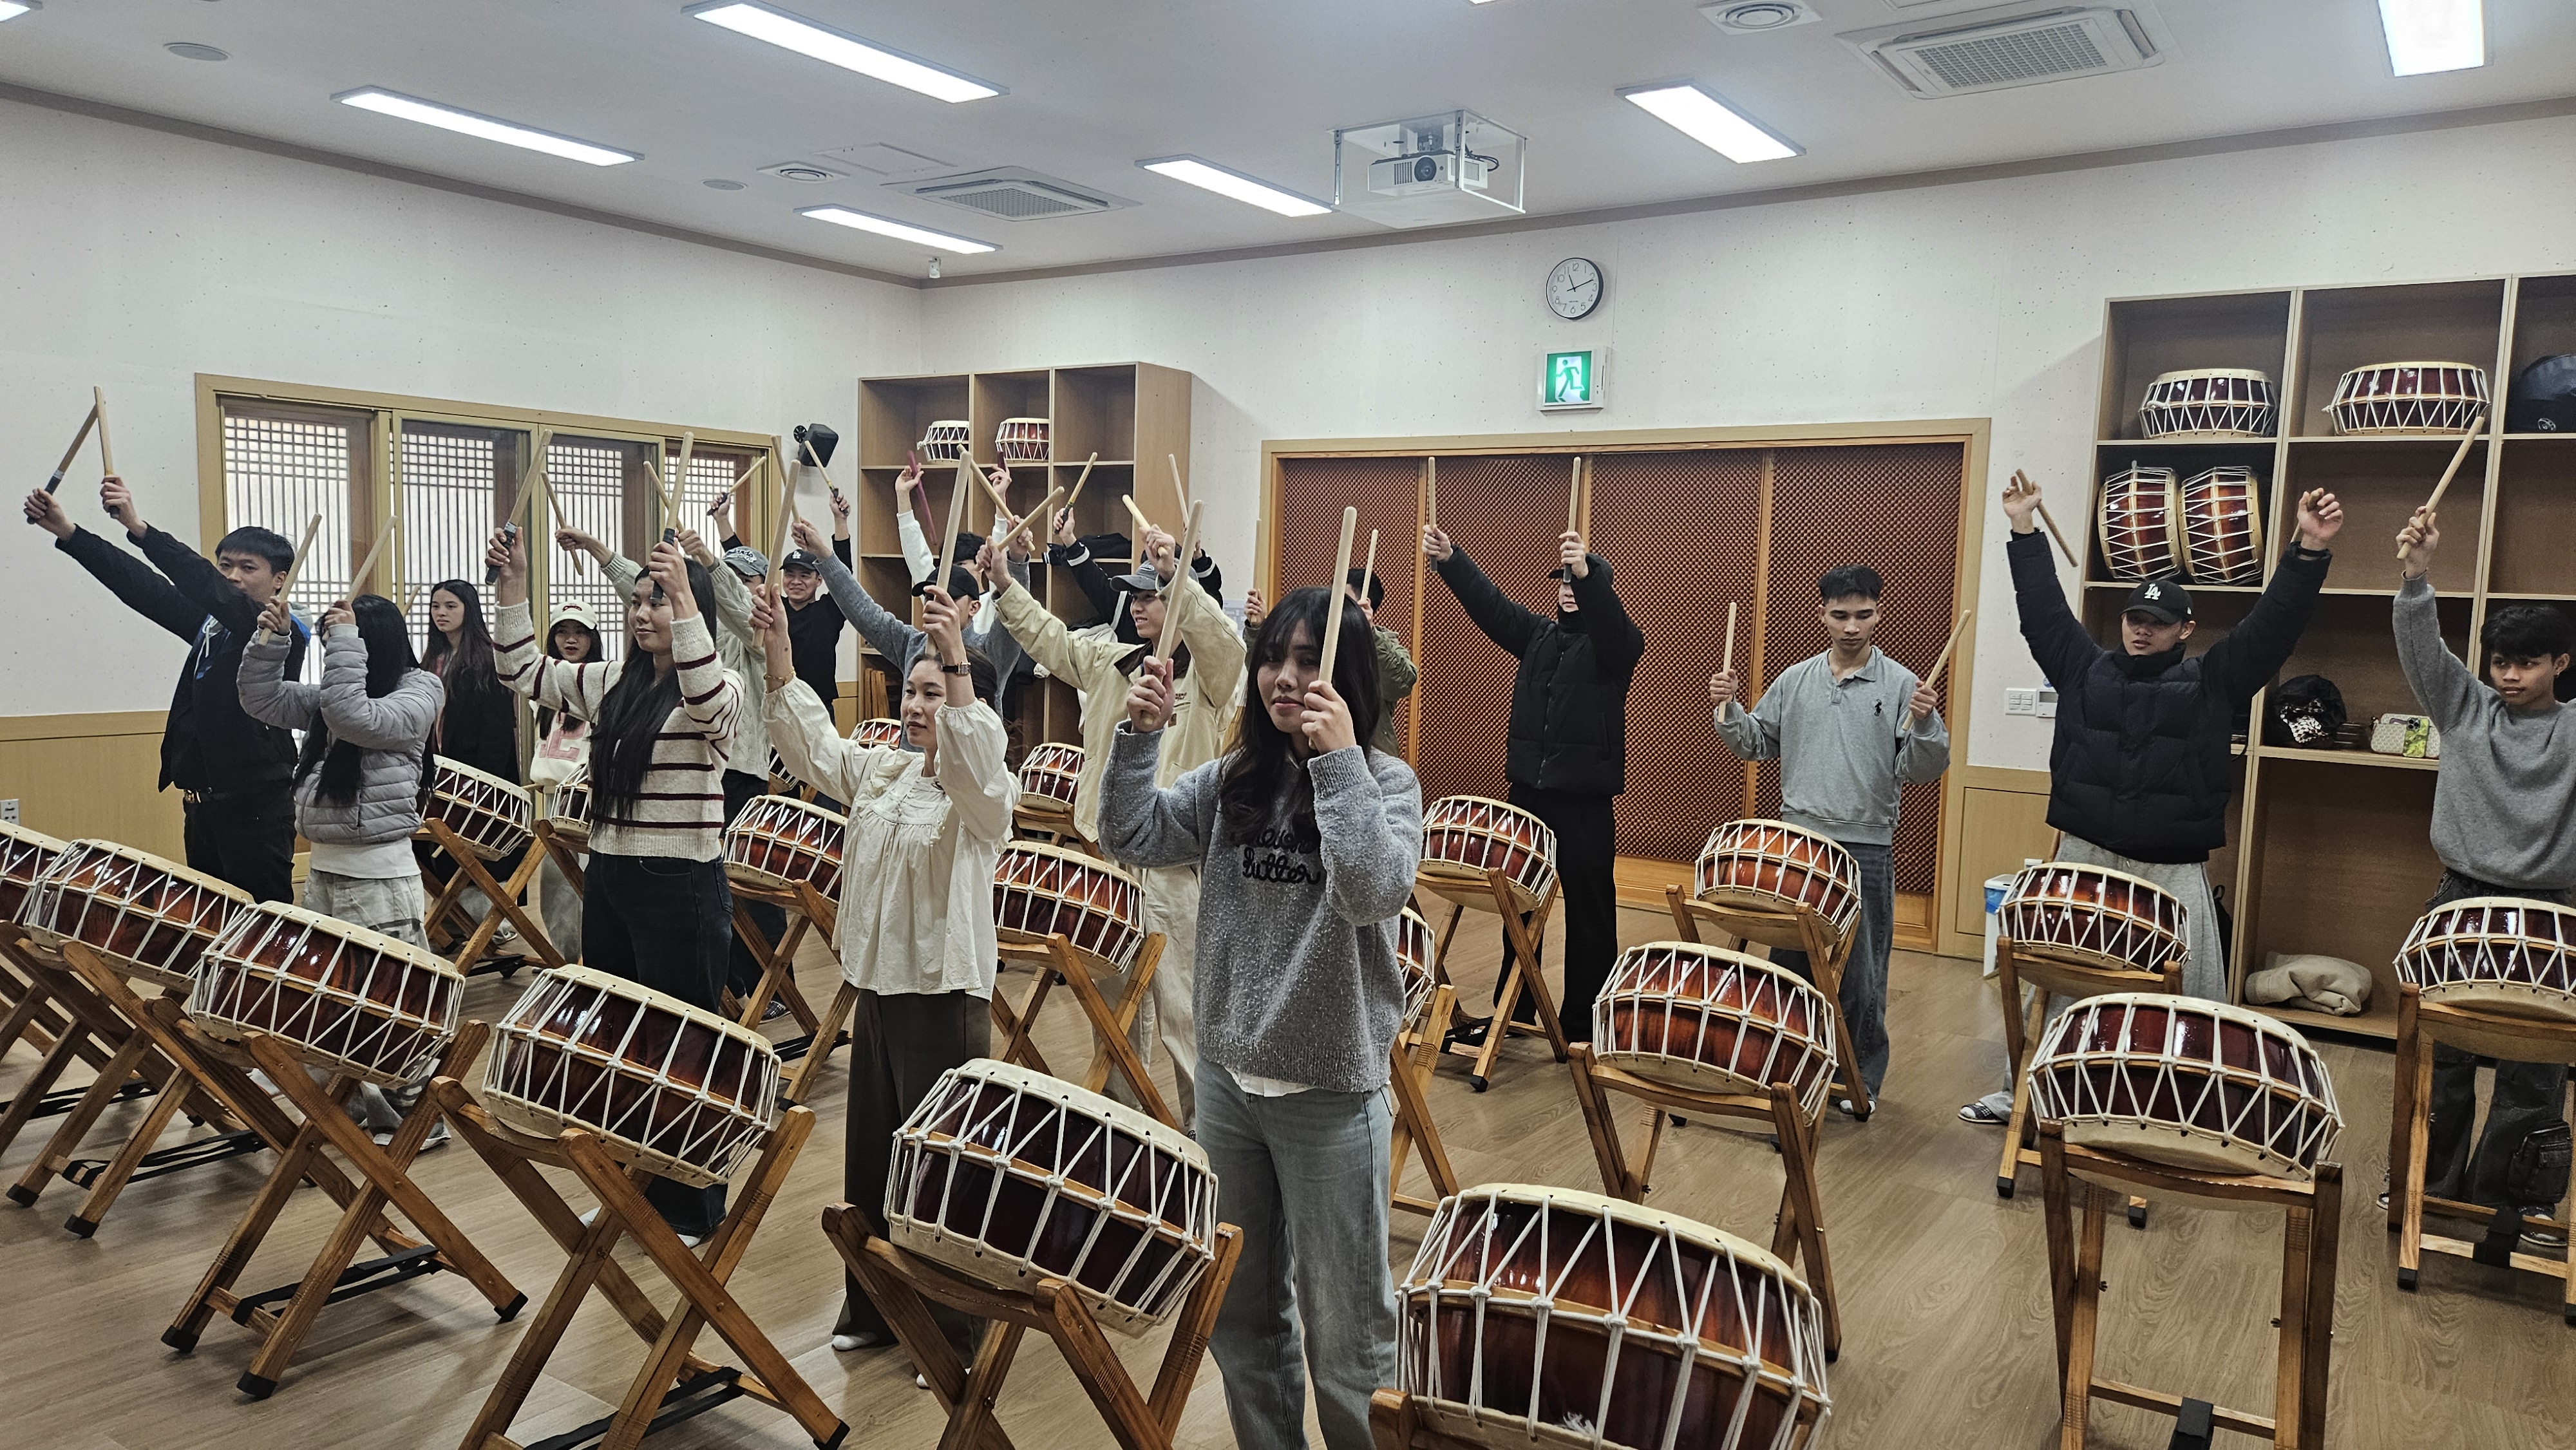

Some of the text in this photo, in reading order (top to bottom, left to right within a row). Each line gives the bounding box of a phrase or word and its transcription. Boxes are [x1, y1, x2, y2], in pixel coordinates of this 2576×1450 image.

[1564, 266, 1569, 275] 11
[1572, 263, 1579, 271] 12
[1557, 274, 1565, 283] 10
[1589, 272, 1595, 281] 2
[1552, 285, 1558, 294] 9
[1592, 283, 1597, 292] 3
[1555, 296, 1560, 305] 8
[1560, 303, 1567, 312] 7
[1570, 306, 1576, 314] 6
[1580, 302, 1586, 310] 5
[792, 551, 801, 559] LA
[2144, 583, 2161, 600] LA
